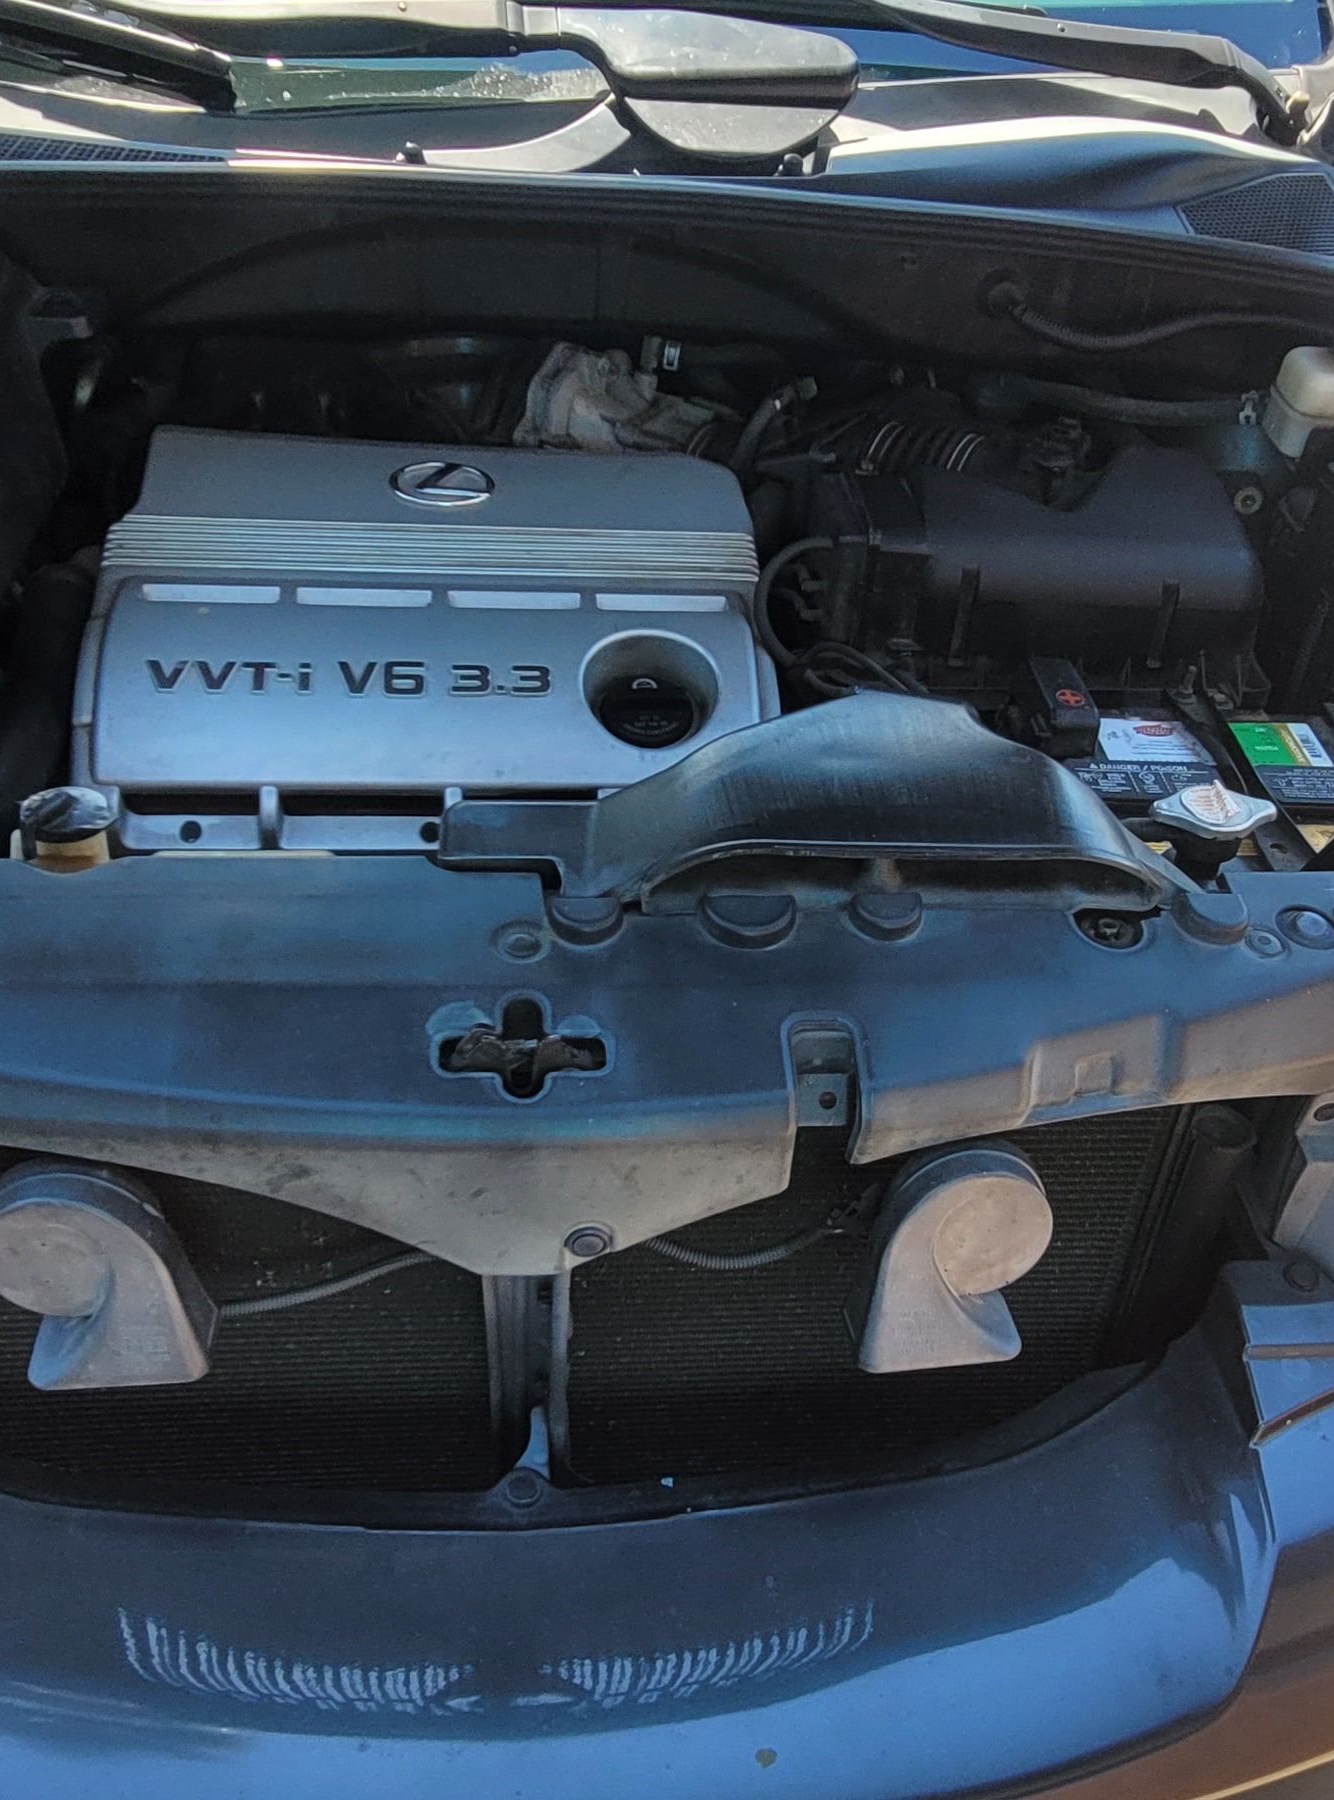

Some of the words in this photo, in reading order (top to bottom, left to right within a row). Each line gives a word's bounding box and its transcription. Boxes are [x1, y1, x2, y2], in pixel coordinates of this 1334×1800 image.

[146, 659, 312, 694] VVT-i
[337, 660, 425, 697] V6
[451, 663, 551, 696] 3.3
[1099, 763, 1140, 772] DANGER
